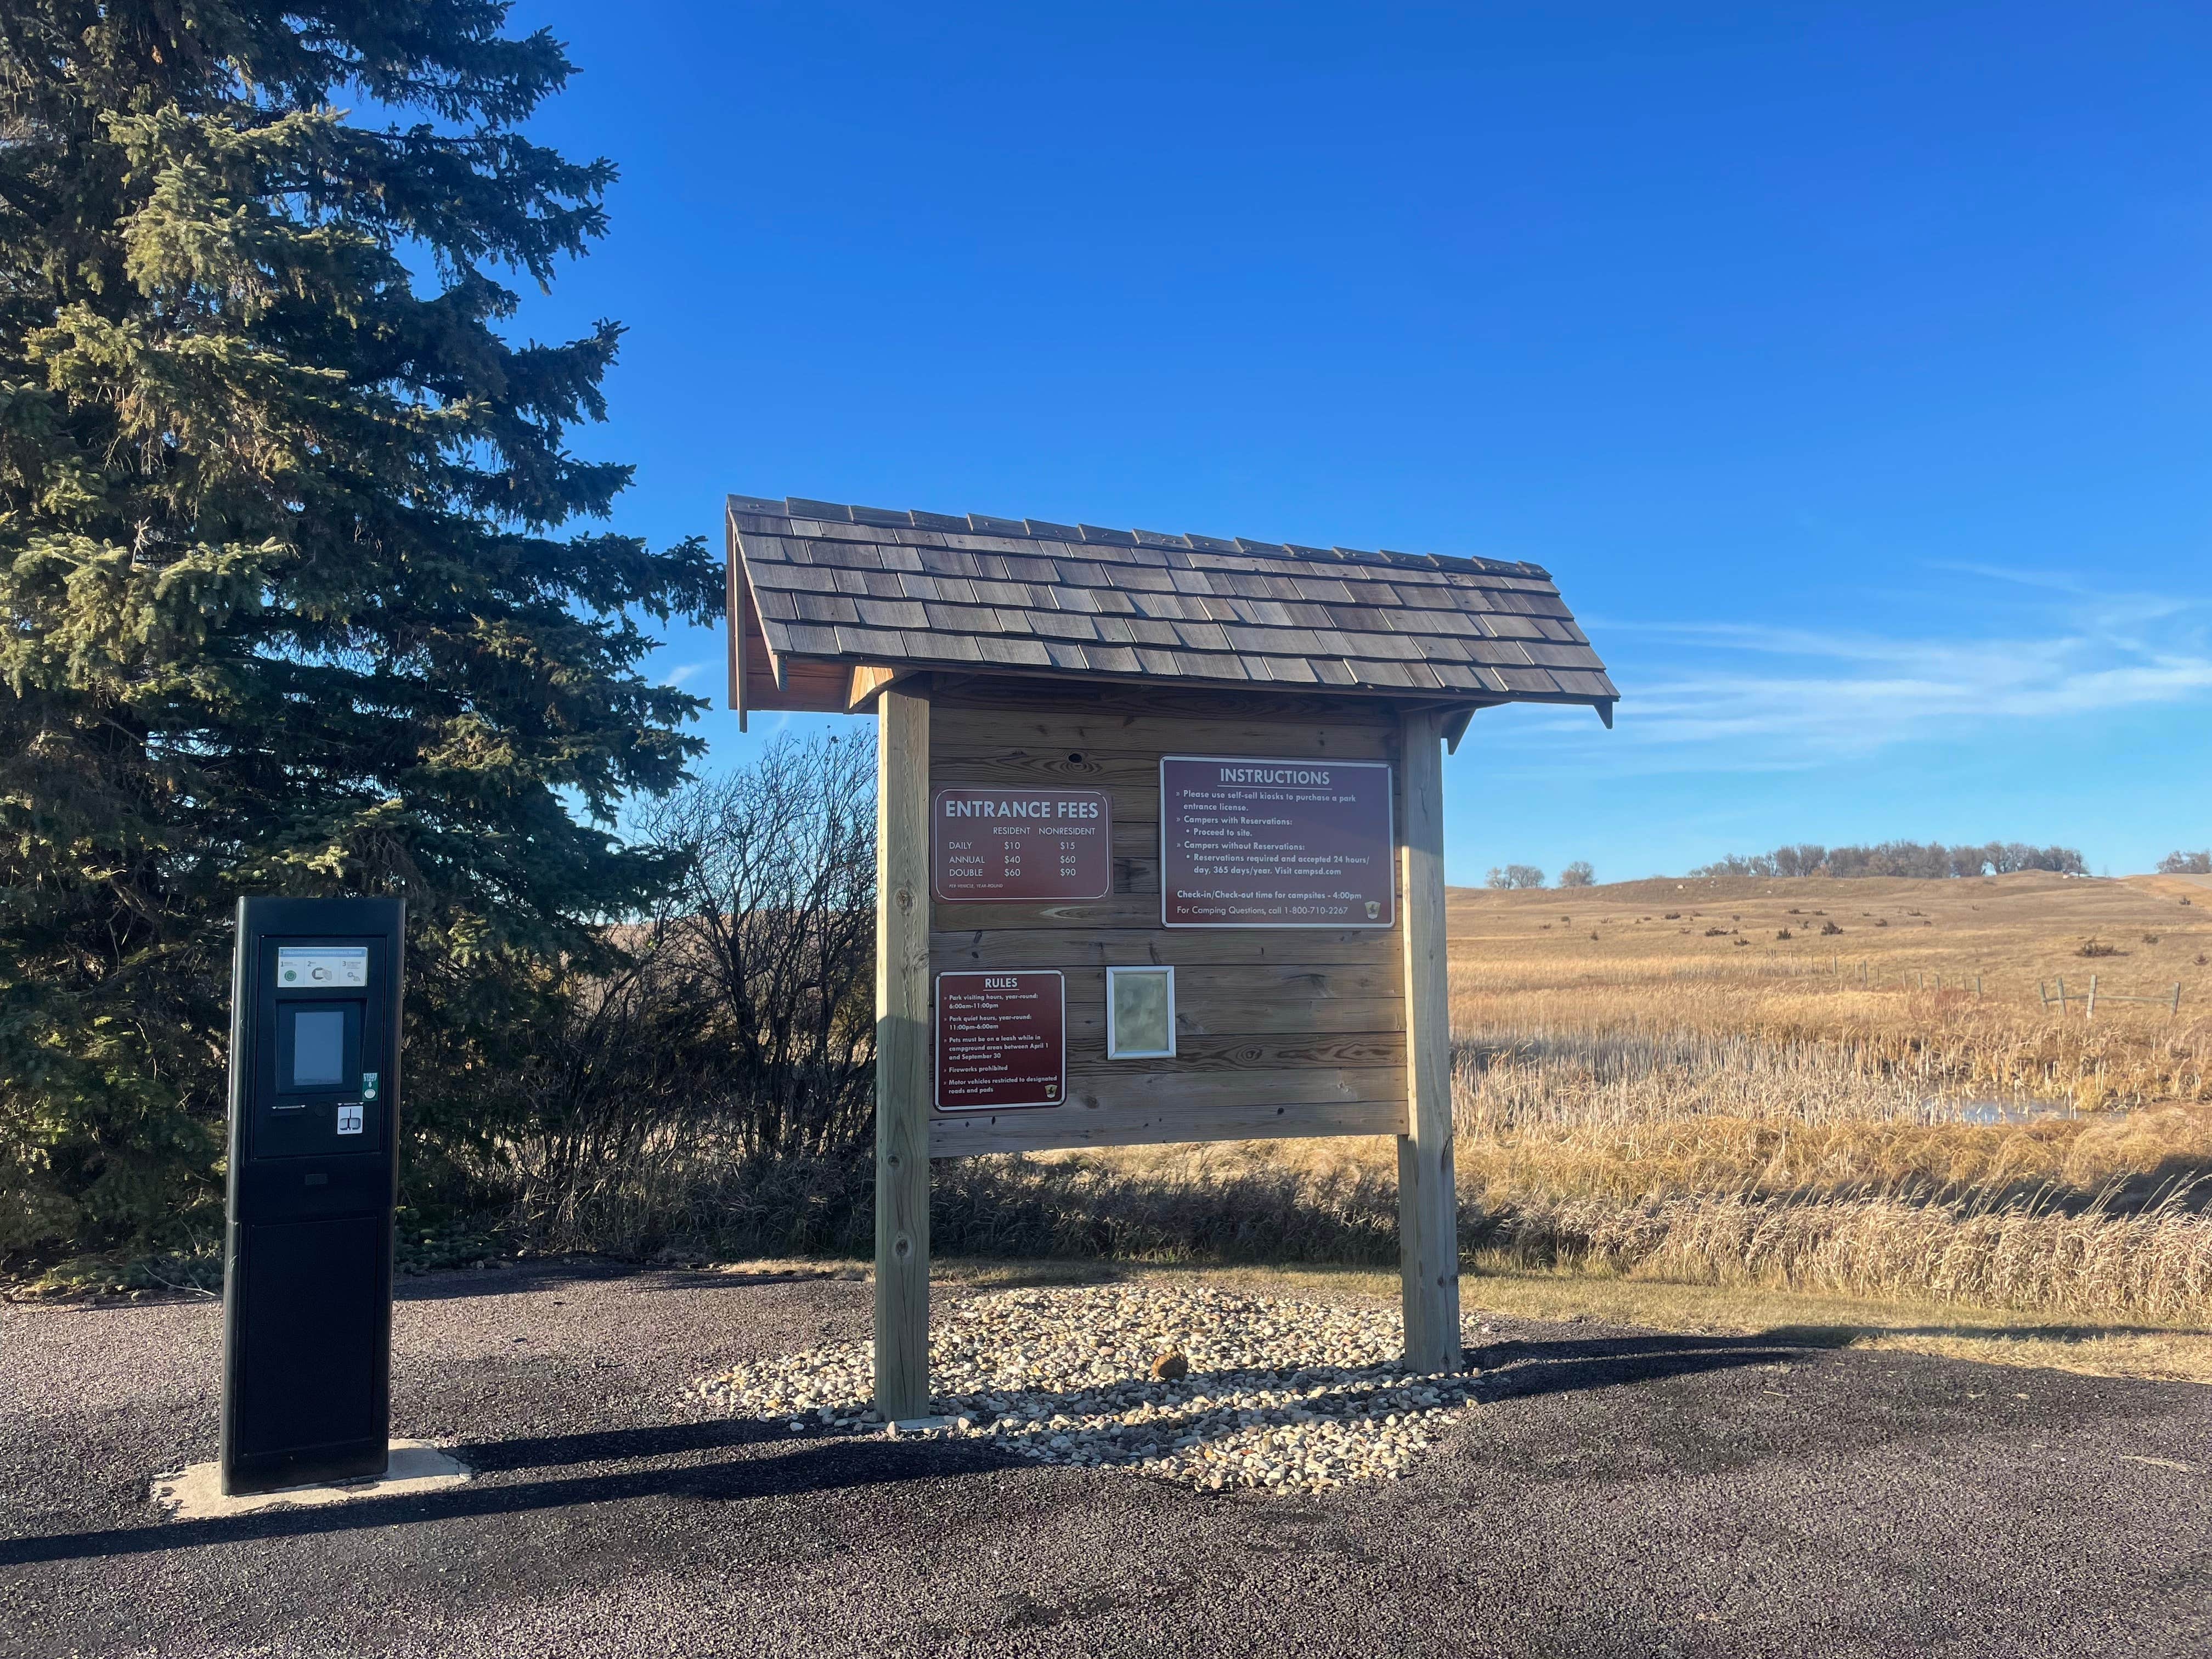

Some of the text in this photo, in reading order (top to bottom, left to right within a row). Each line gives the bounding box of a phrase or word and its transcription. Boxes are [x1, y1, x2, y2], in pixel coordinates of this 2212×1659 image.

[1221, 768, 1330, 785] INSTRUCTIONS
[1296, 794, 1330, 802] purchase
[1339, 795, 1356, 803] park
[946, 800, 1098, 818] ENTRANCE FEES
[1184, 815, 1218, 825] Campers
[1240, 817, 1293, 825] Reservations:
[1004, 842, 1020, 850] $10
[1060, 842, 1075, 850] $15
[1184, 841, 1218, 850] Campers
[1254, 842, 1305, 850] Reservations:
[1005, 855, 1020, 864] $40
[1060, 855, 1076, 864] $60
[1246, 854, 1279, 863] required
[1298, 856, 1331, 864] accepted
[1345, 856, 1369, 865] hours/
[1005, 868, 1020, 877] $60
[1060, 868, 1076, 877] $90
[1194, 866, 1210, 874] day,
[1231, 866, 1272, 876] days/year.
[1294, 867, 1341, 876] campsd.com
[1177, 890, 1253, 900] Check-in/Check-out
[1288, 891, 1325, 900] campsites
[1333, 892, 1362, 900] 4:00pm
[1192, 906, 1226, 915] Camping
[1228, 906, 1266, 915] Questions,
[985, 978, 1018, 988] RULES
